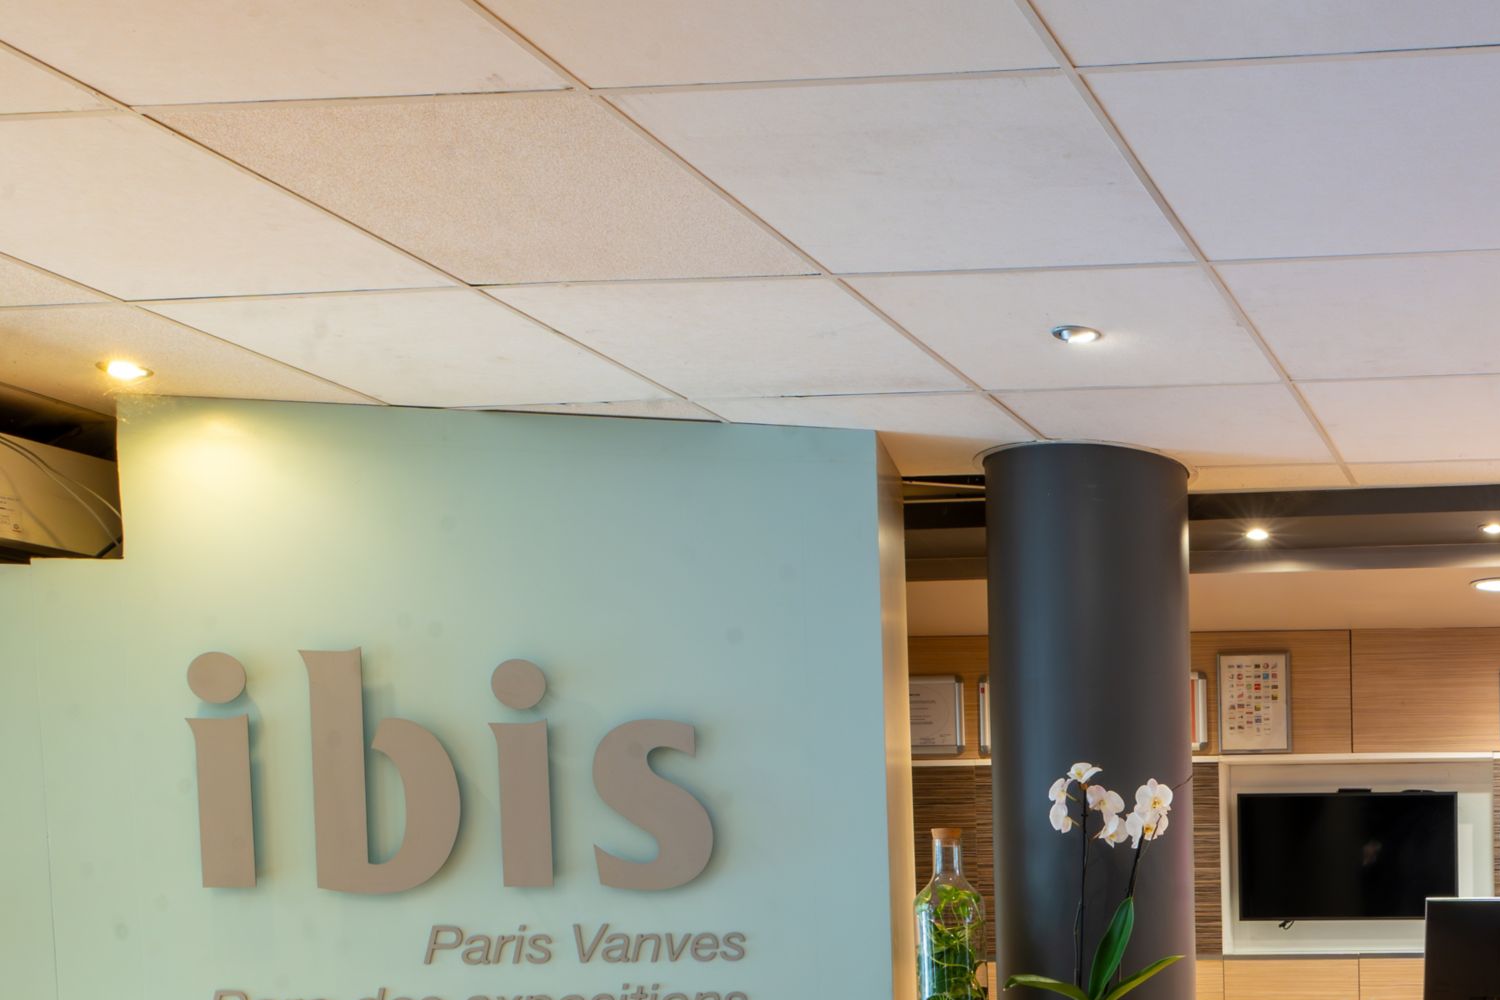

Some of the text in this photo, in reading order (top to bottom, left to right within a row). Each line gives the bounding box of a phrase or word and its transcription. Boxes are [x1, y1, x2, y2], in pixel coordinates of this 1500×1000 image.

[184, 646, 714, 894] ibis
[423, 923, 748, 966] Paris Vanves
